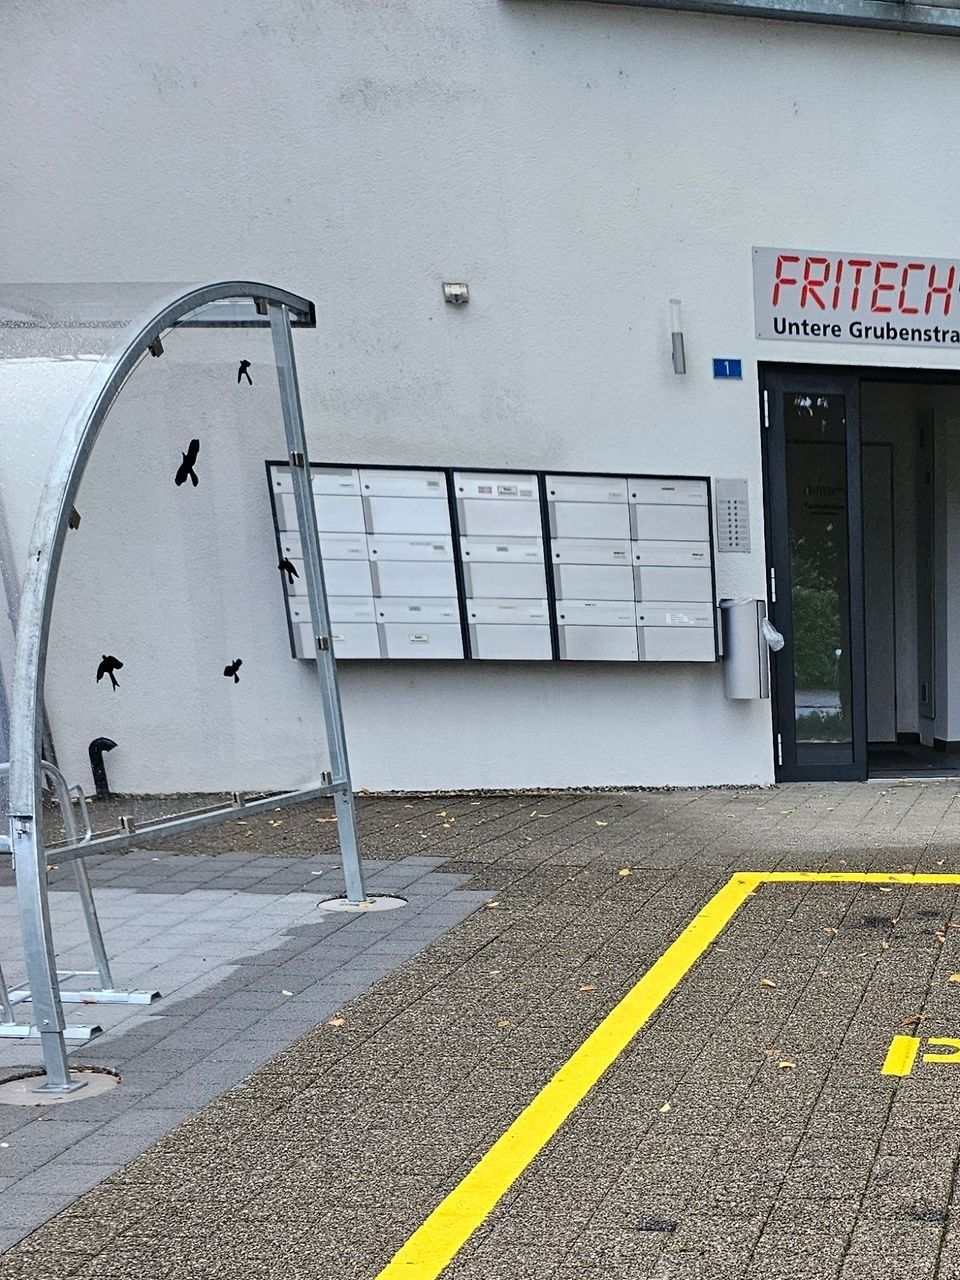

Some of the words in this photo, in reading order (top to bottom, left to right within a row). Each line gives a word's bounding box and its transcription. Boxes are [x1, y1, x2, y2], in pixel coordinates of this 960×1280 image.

[772, 255, 955, 317] FRITECH
[773, 317, 842, 338] Untere
[724, 361, 729, 376] 1
